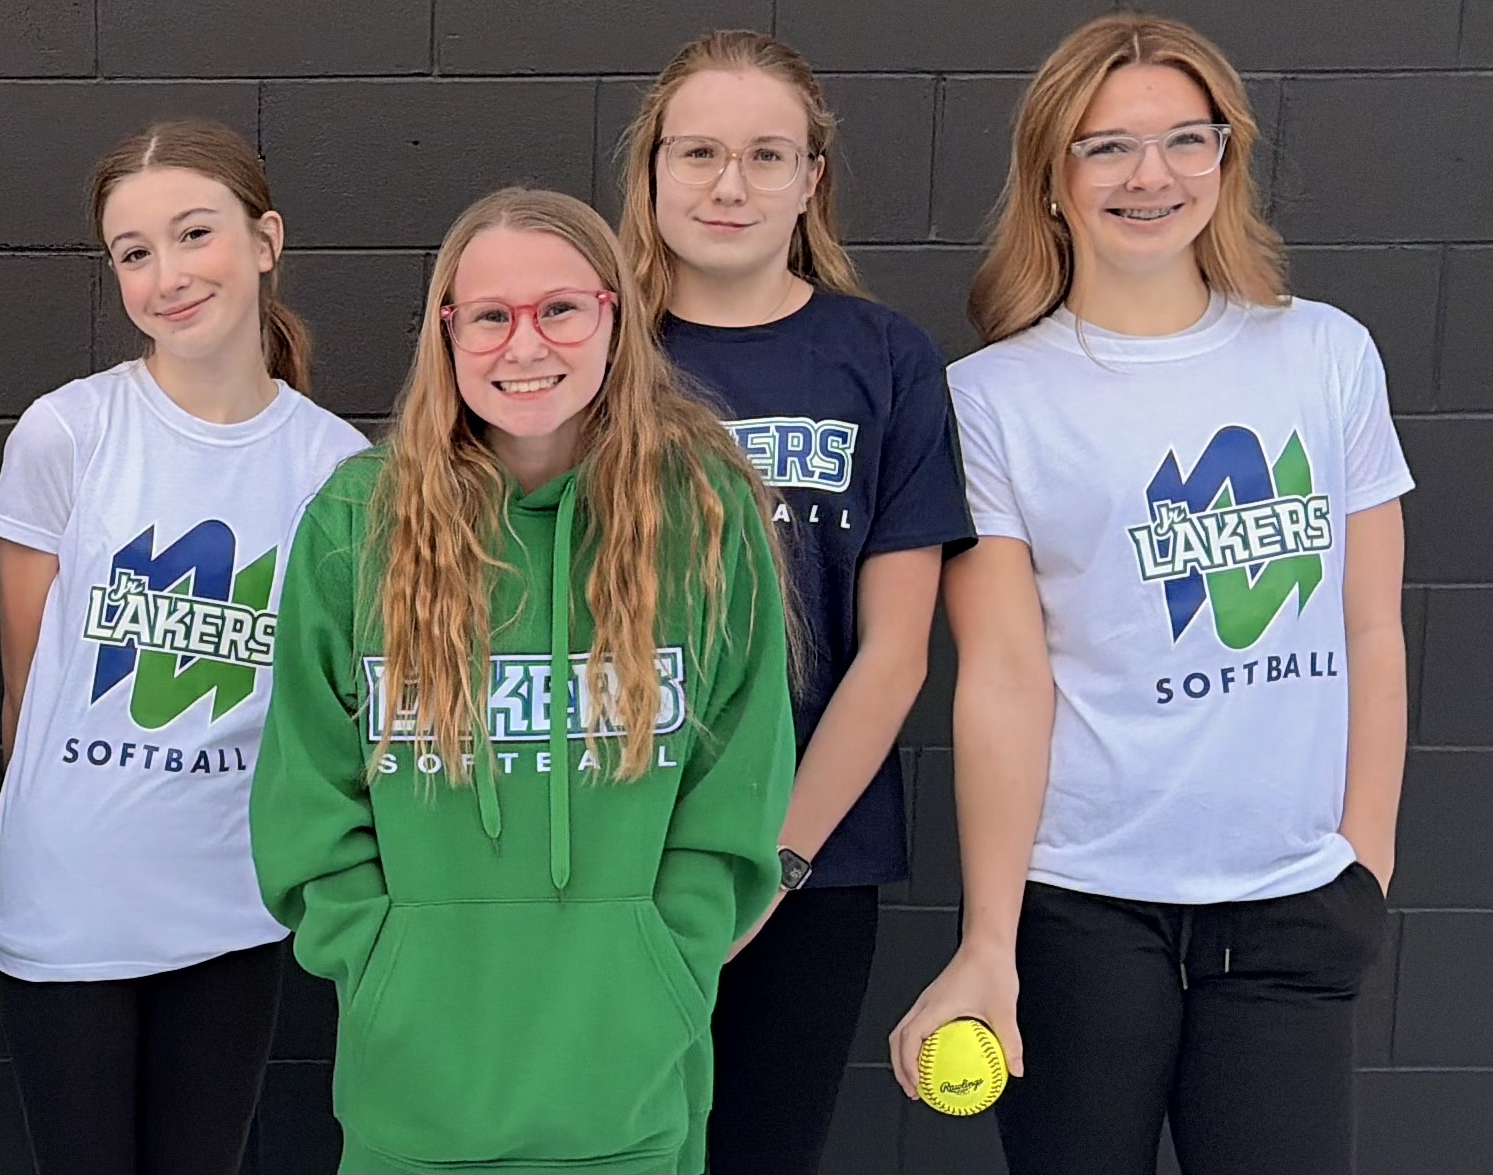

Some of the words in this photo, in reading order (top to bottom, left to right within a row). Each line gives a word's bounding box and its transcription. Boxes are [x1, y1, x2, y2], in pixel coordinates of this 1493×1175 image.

[1132, 495, 1332, 581] LAKERS
[1154, 503, 1188, 536] Jr
[110, 571, 146, 599] Jr
[83, 586, 276, 665] LAKERS
[1156, 652, 1338, 704] SOFTBALL
[62, 738, 247, 774] SOFTBALL
